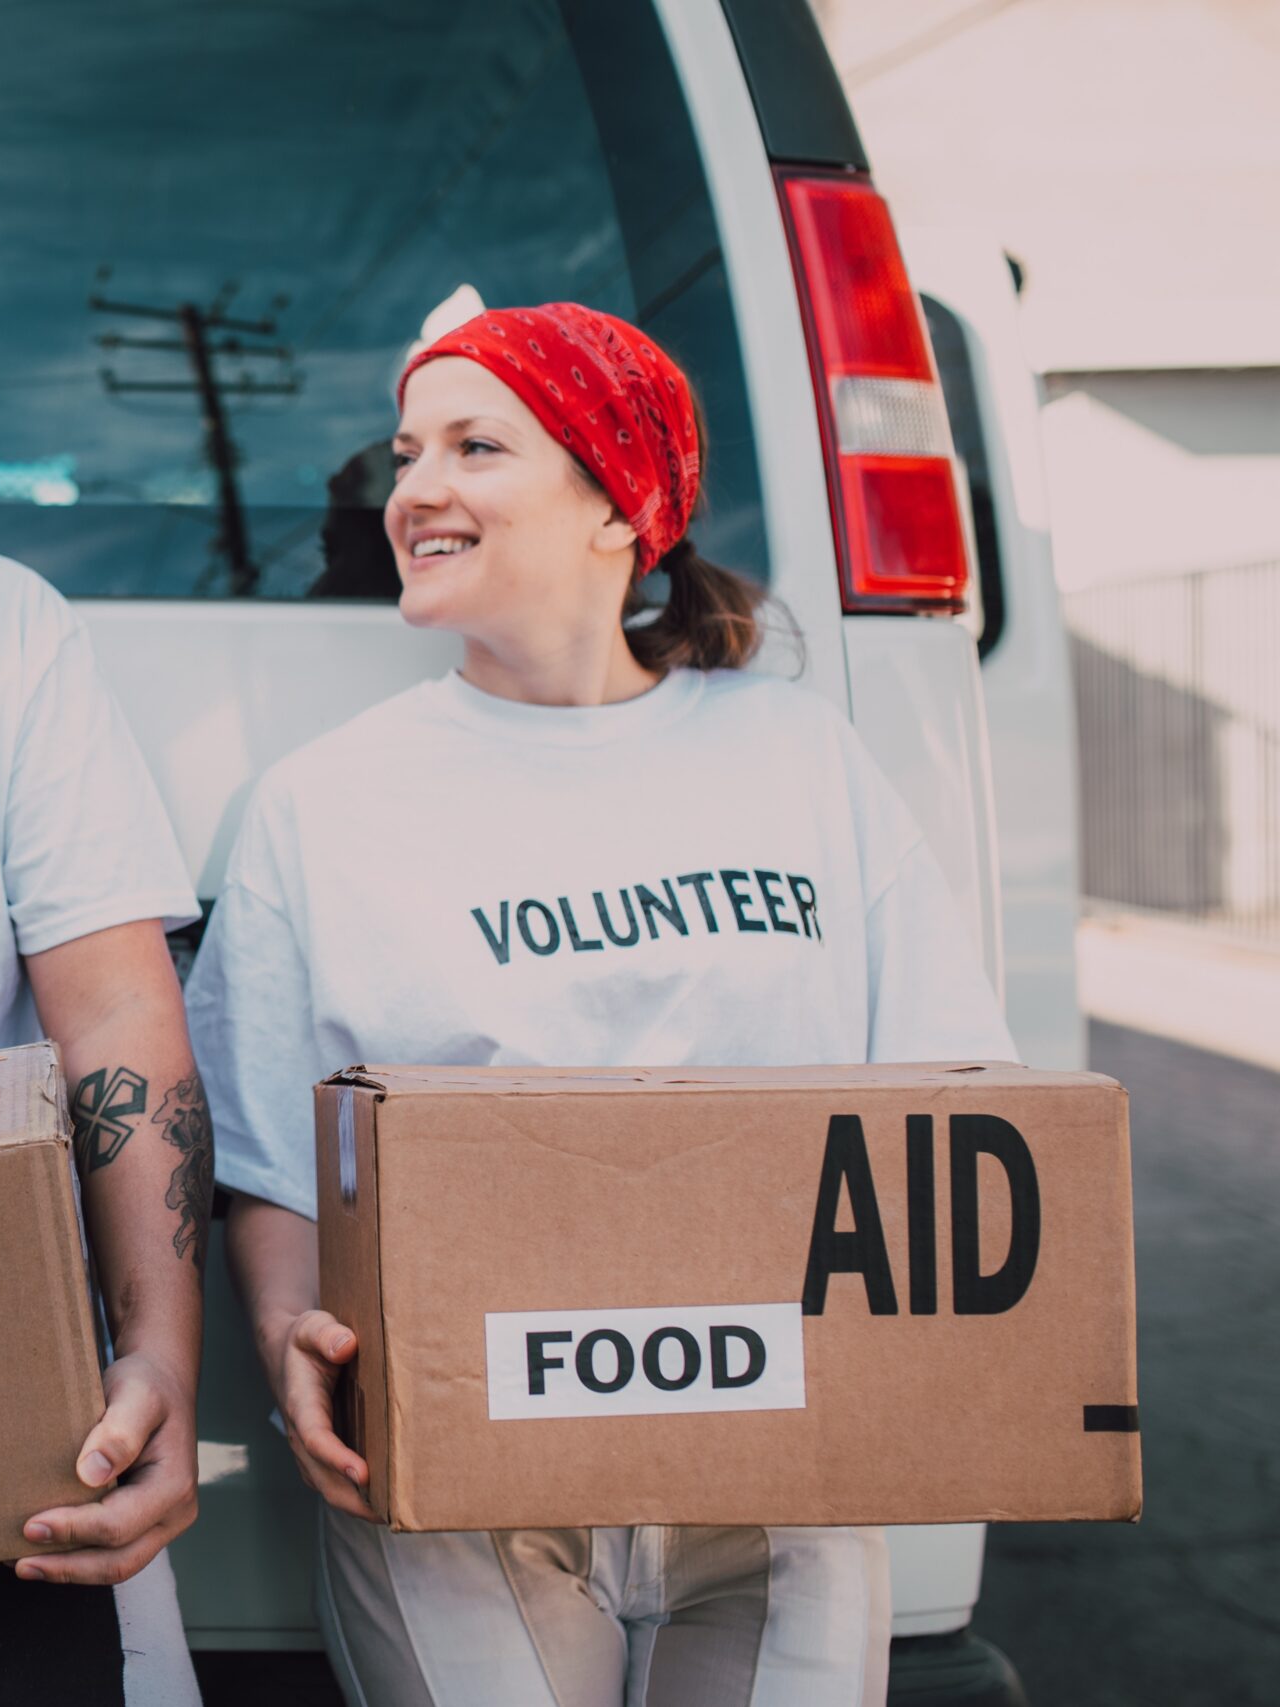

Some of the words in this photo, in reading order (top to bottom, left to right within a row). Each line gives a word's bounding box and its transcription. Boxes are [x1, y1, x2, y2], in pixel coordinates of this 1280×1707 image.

[470, 869, 824, 965] VOLUNTEER
[800, 1113, 1041, 1316] AID
[525, 1325, 767, 1396] FOOD
